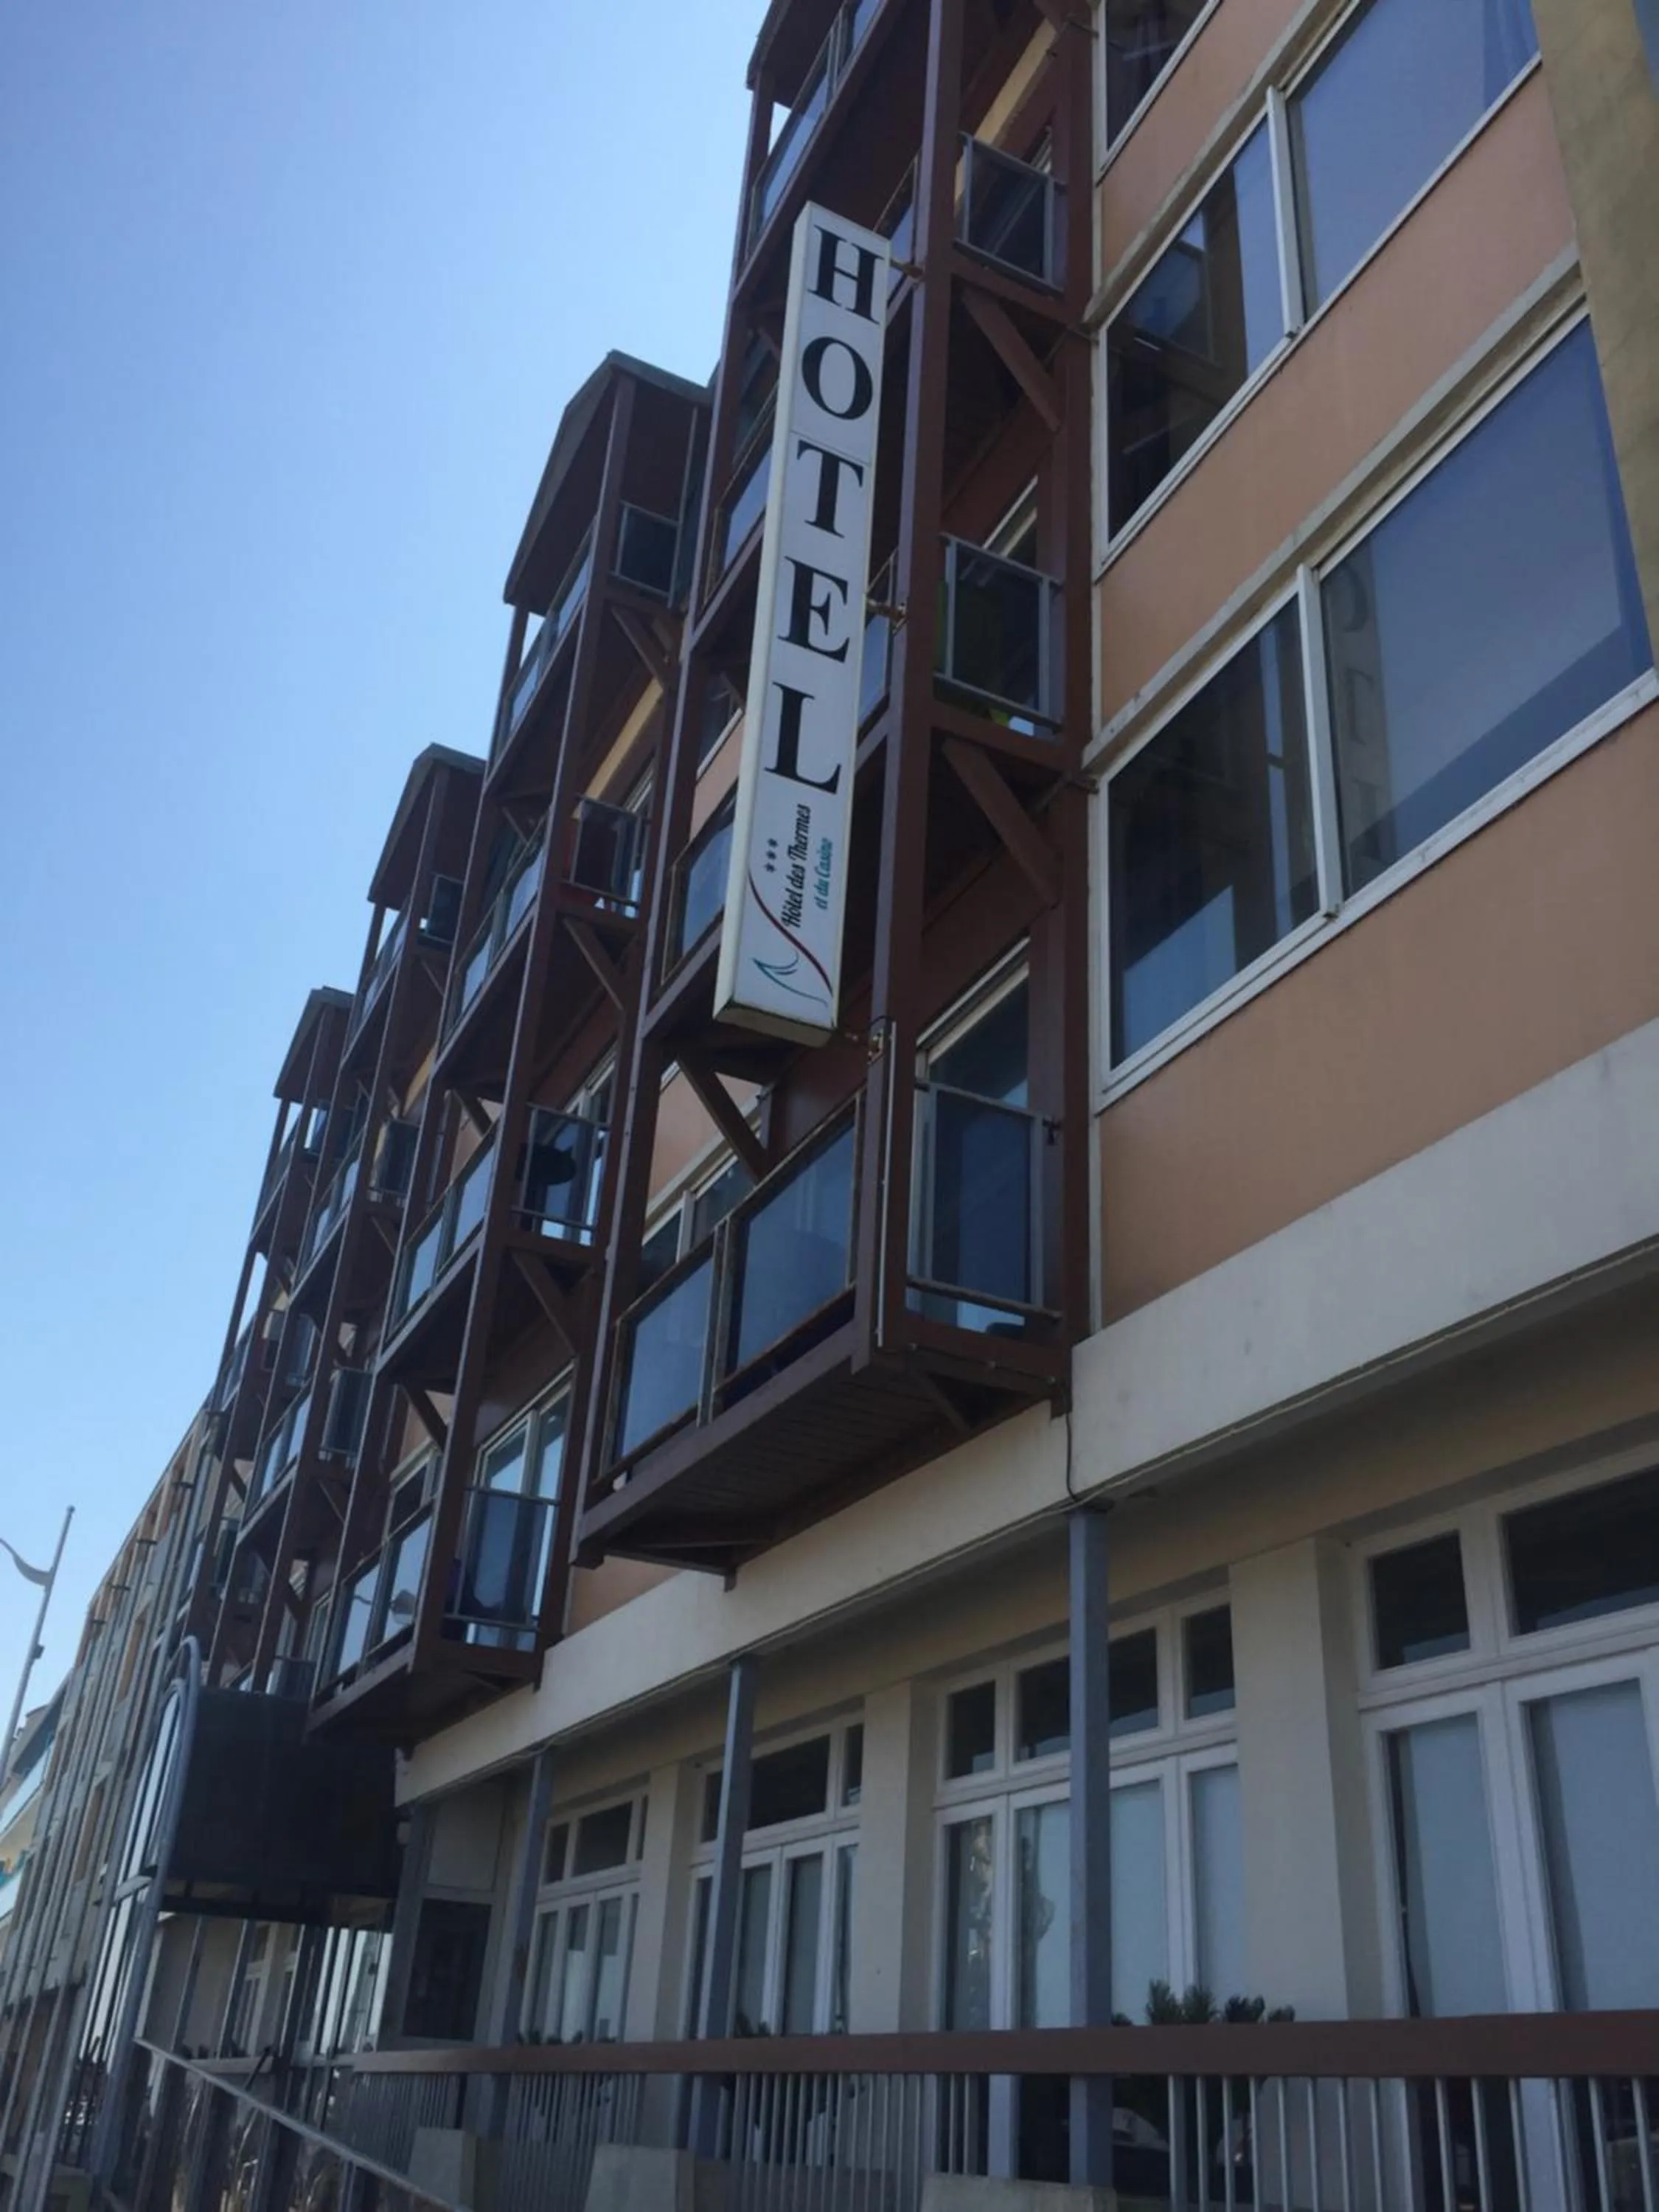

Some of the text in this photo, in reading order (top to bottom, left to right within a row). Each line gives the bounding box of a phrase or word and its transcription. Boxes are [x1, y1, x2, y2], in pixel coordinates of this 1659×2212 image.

[762, 224, 885, 795] HOTEL
[781, 803, 812, 928] Hôtel des Thermes
[813, 878, 830, 897] du
